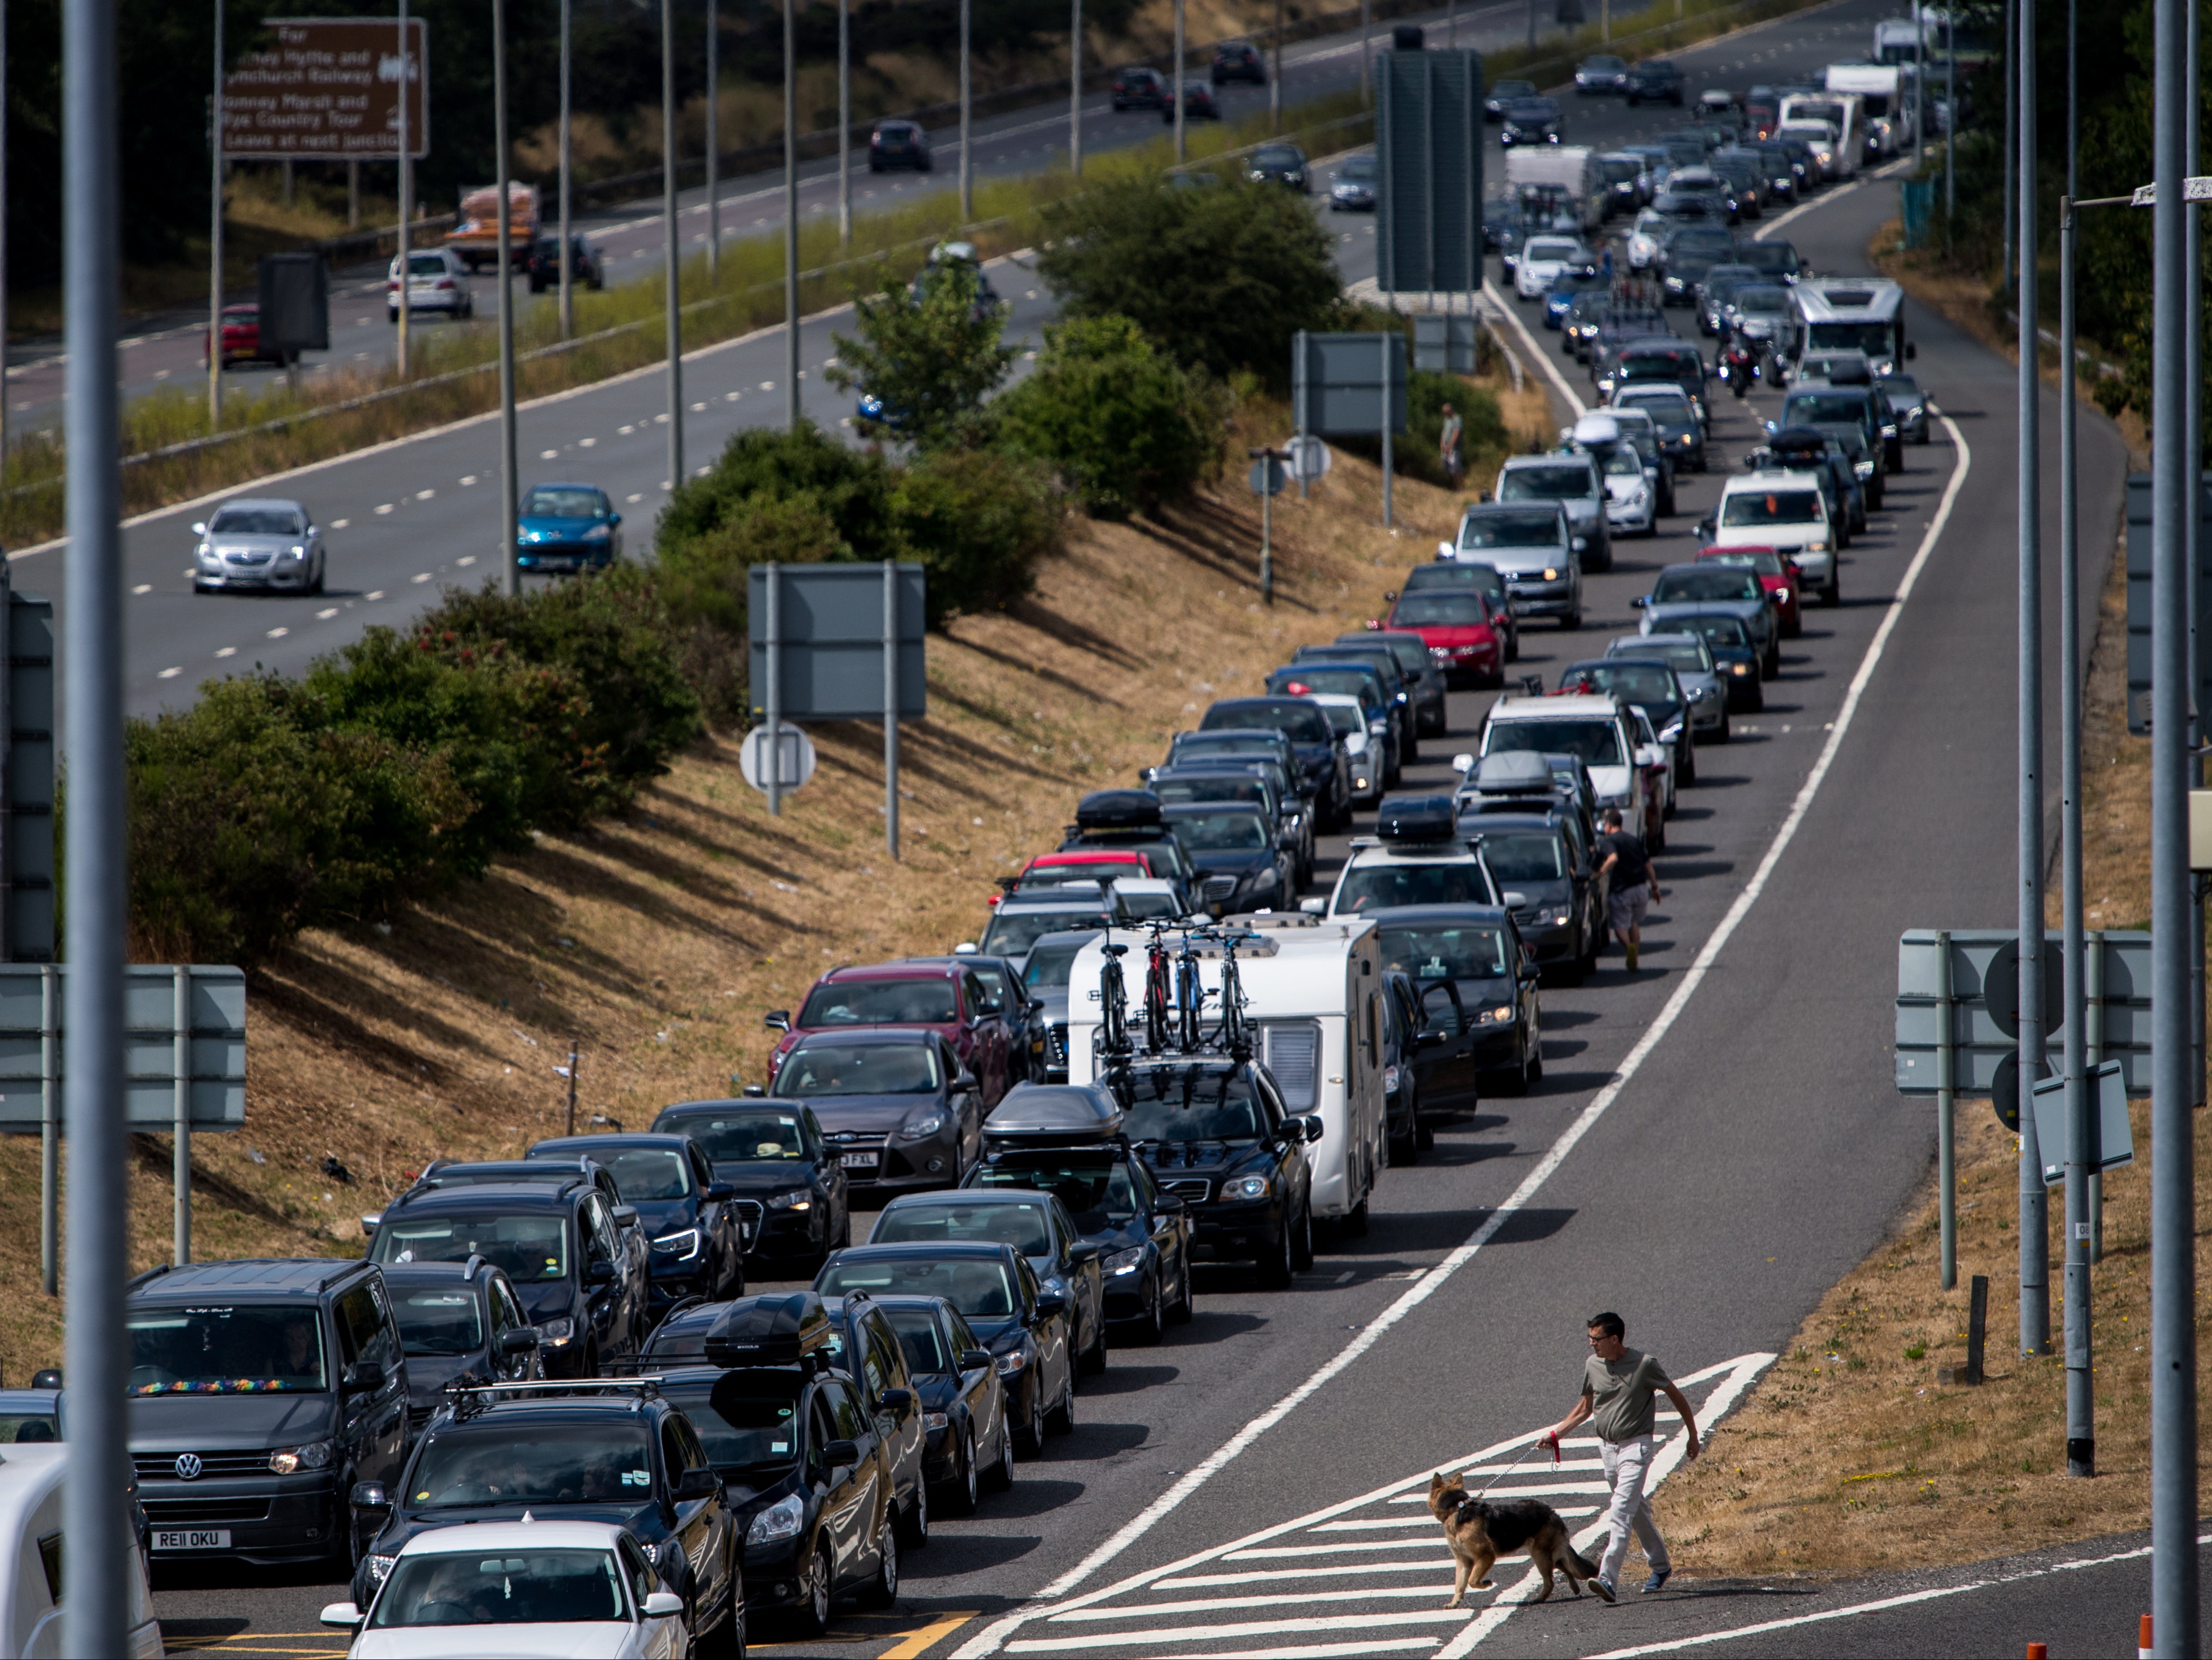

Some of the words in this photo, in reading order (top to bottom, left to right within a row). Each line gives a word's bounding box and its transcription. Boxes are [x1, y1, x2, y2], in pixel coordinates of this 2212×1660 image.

[278, 28, 309, 43] For
[284, 50, 334, 68] Hythe
[338, 49, 371, 66] and
[224, 67, 305, 86] ymchurch
[308, 67, 373, 87] Railway
[222, 95, 278, 112] omney
[281, 93, 333, 111] Marsh
[336, 94, 370, 111] and
[255, 110, 322, 131] Country
[327, 109, 364, 129] Tour
[225, 132, 275, 150] Leave
[277, 132, 297, 149] at
[300, 132, 339, 149] next
[341, 132, 400, 150] junctio
